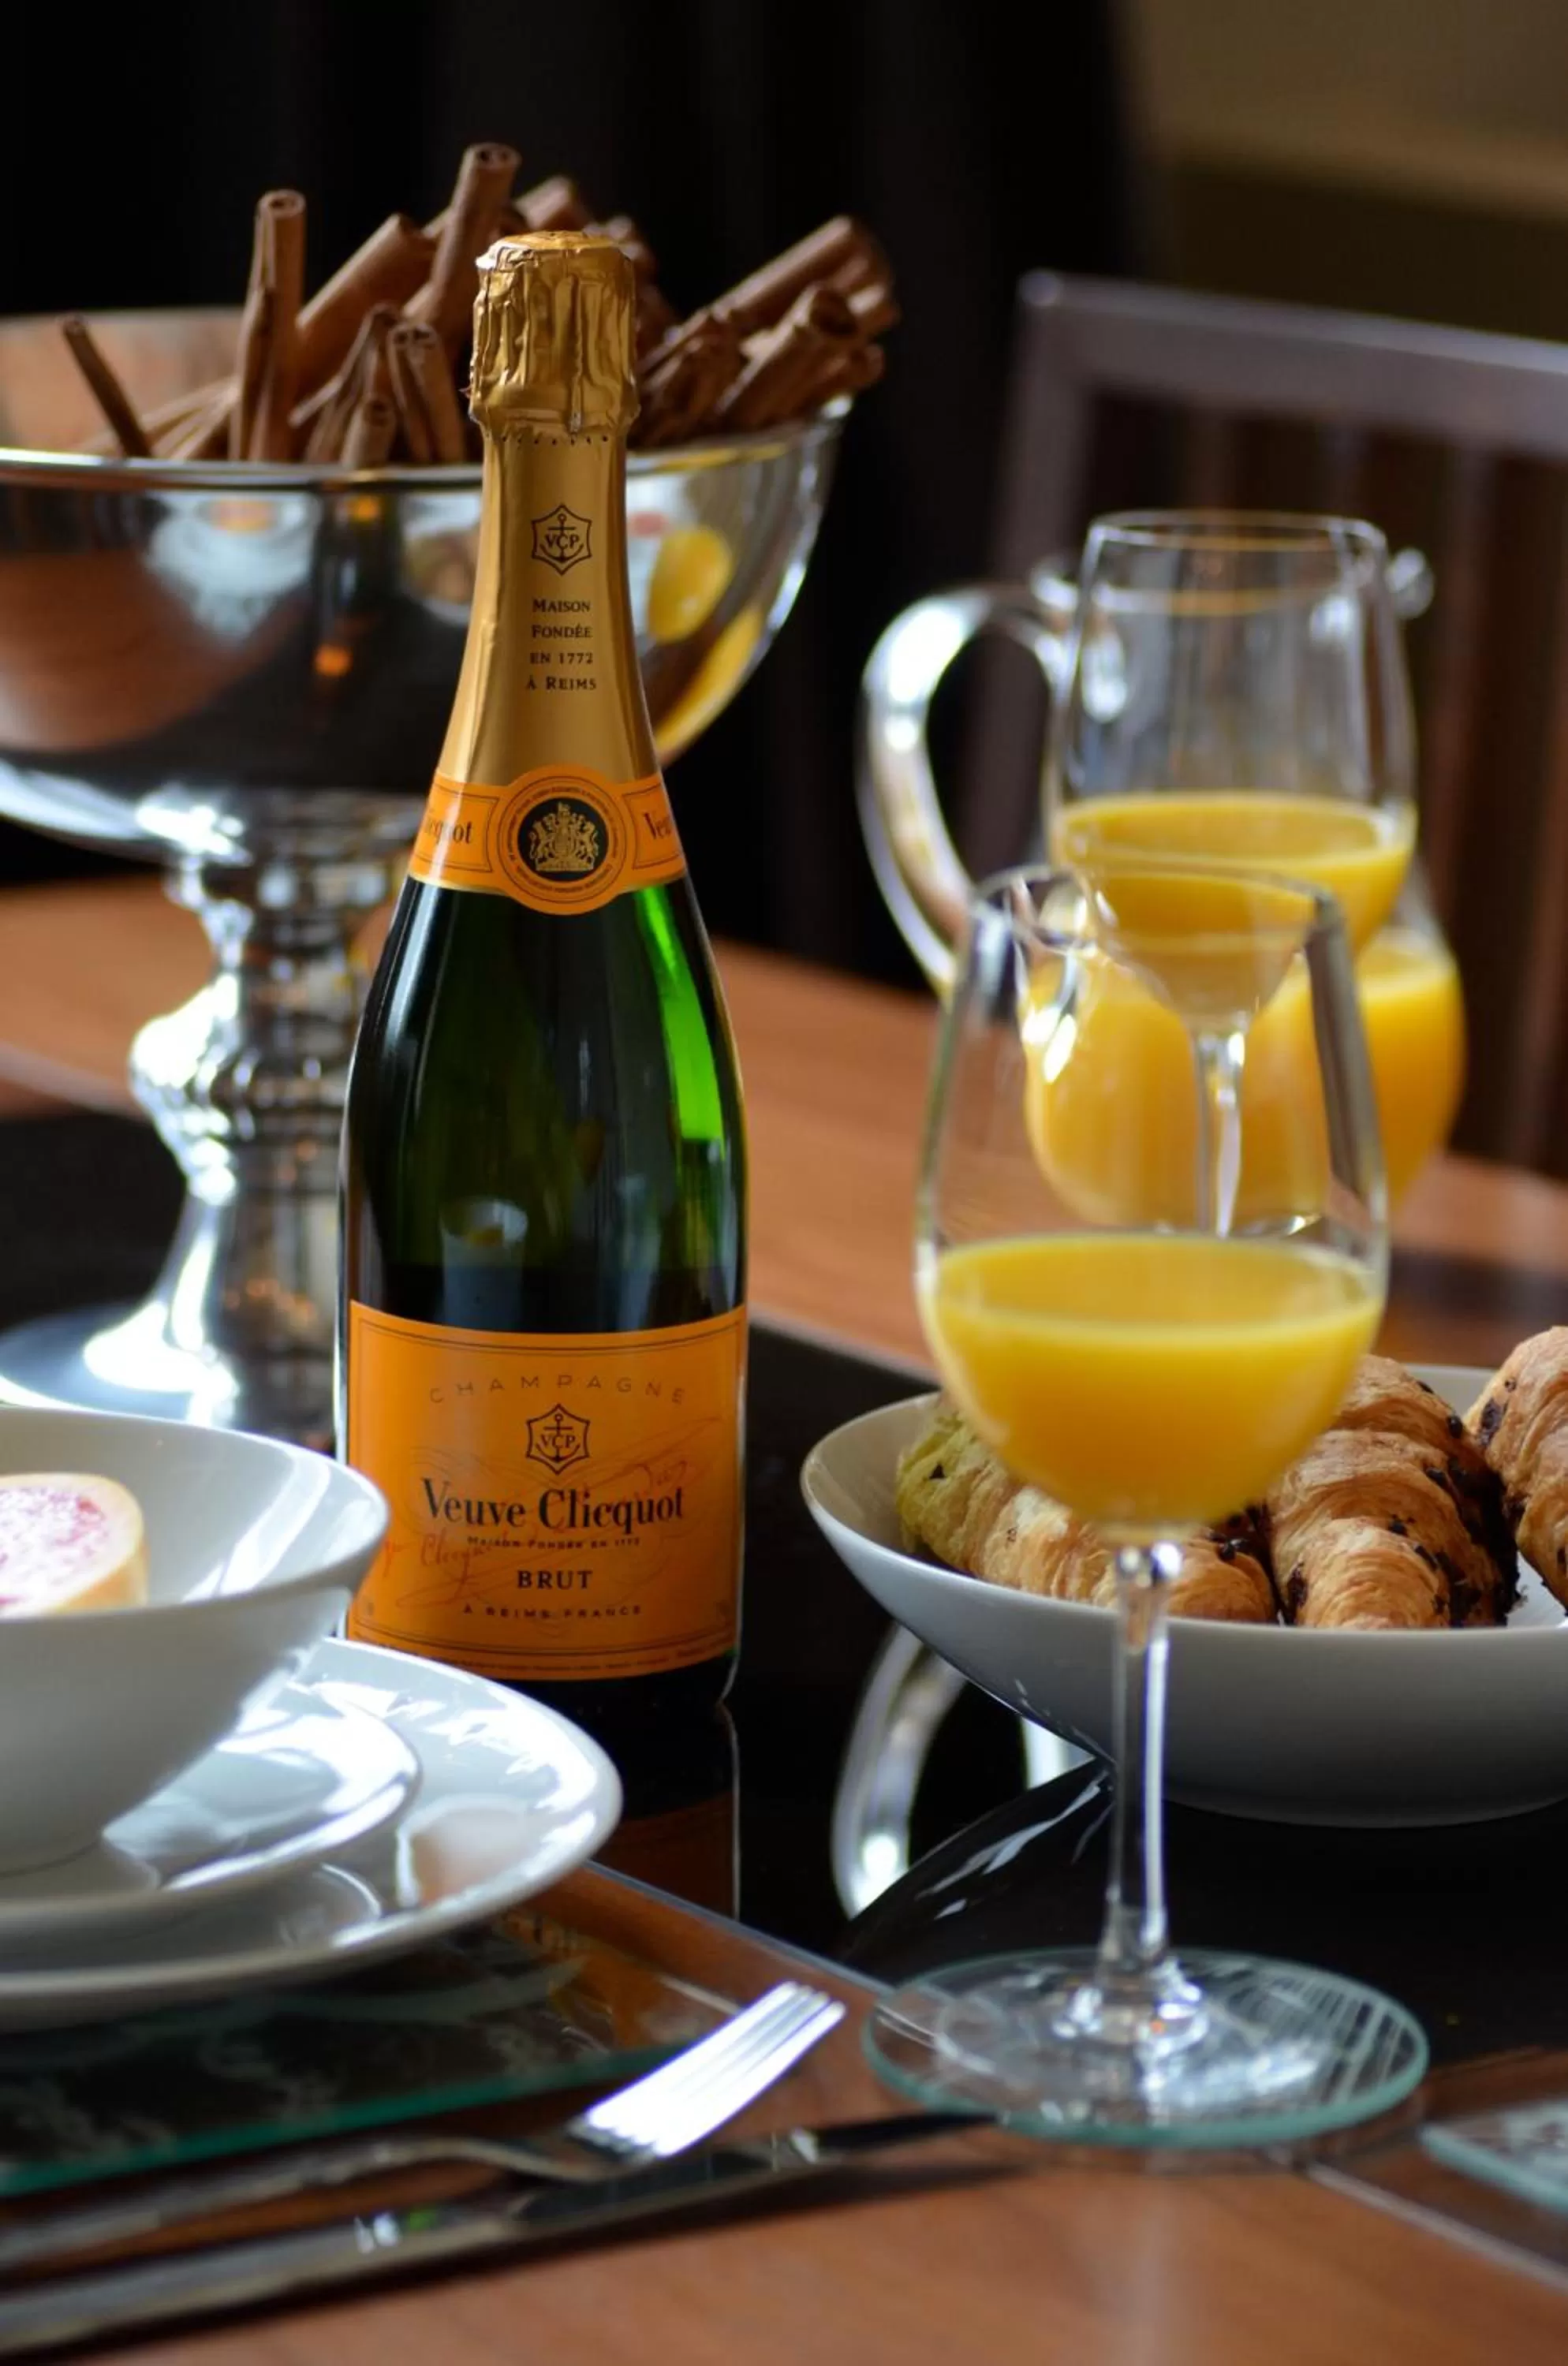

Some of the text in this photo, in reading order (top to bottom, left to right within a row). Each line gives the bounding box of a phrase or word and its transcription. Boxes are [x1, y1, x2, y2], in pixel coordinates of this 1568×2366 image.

[532, 599, 592, 613] MAISON
[531, 623, 594, 639] FONDÉE
[558, 652, 594, 665] 1772
[545, 677, 597, 691] REIMS
[429, 1373, 685, 1405] CHAMPAGNE
[421, 1477, 684, 1535] Veuve Clicquot
[517, 1569, 593, 1590] BRUT
